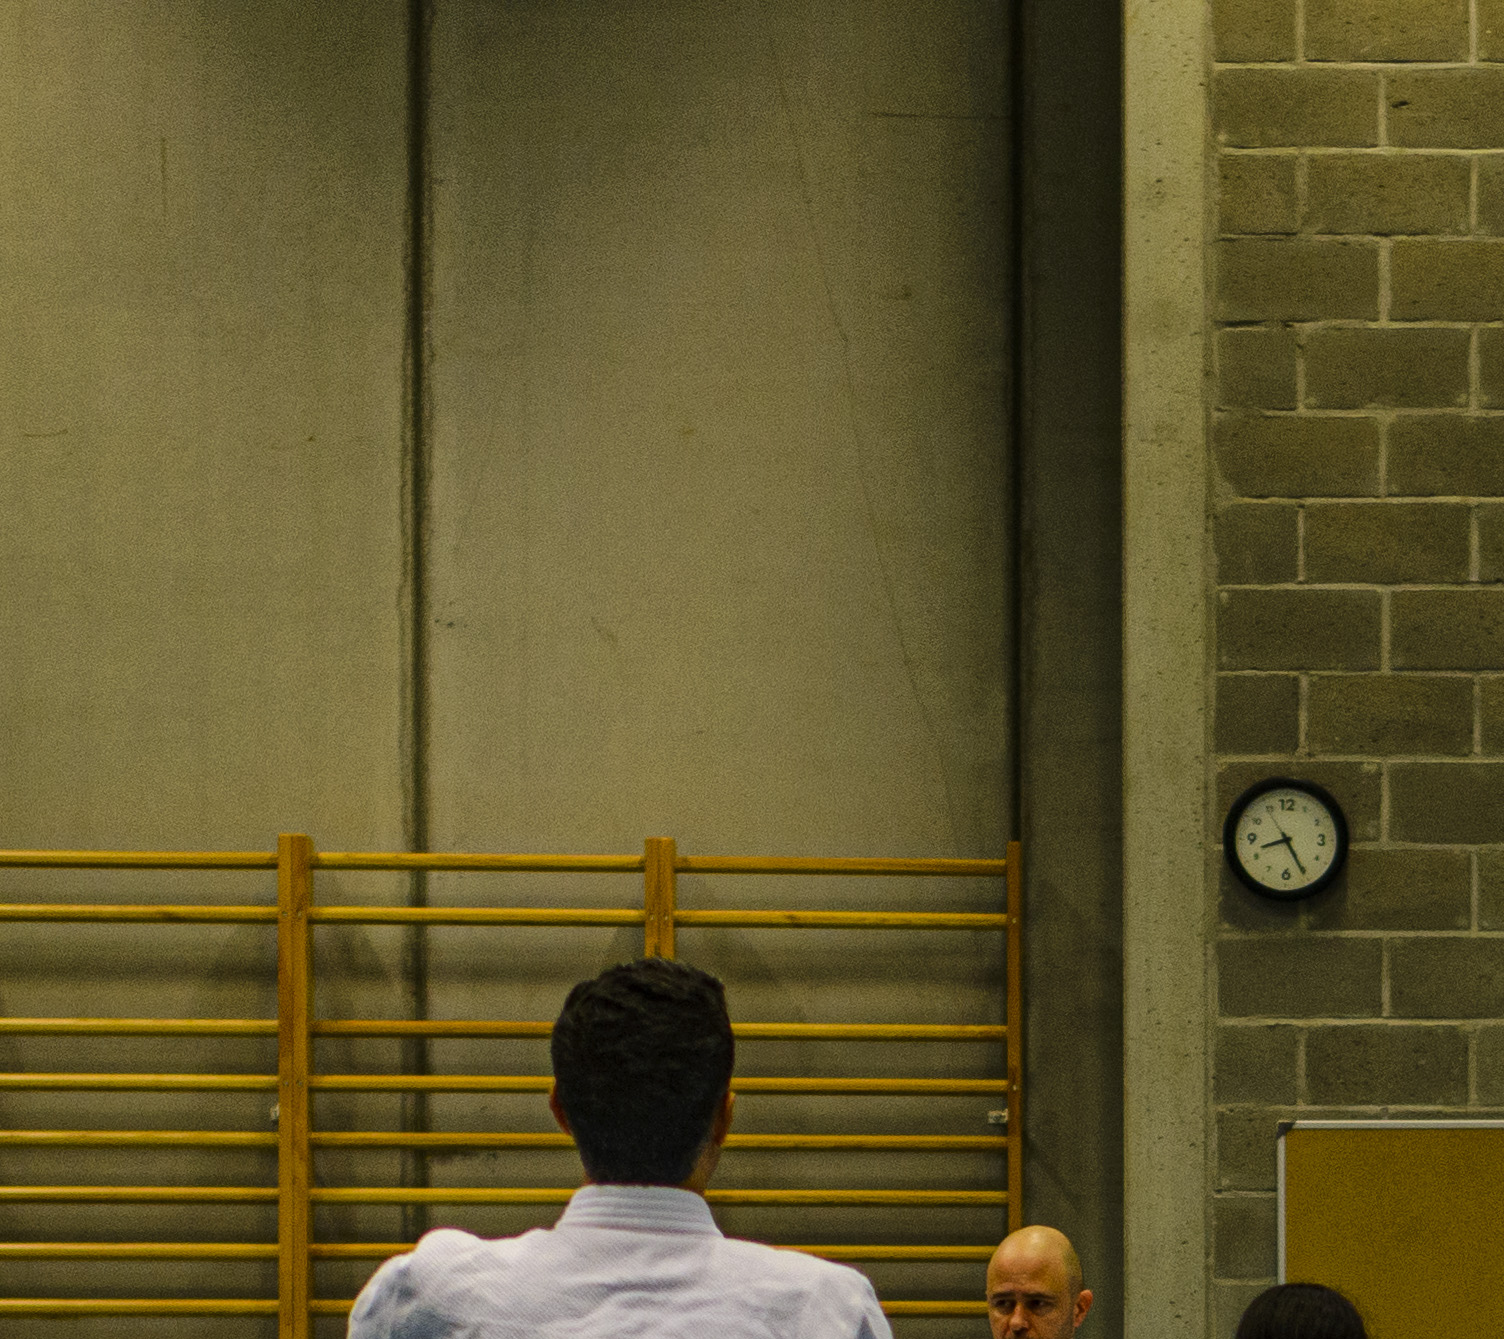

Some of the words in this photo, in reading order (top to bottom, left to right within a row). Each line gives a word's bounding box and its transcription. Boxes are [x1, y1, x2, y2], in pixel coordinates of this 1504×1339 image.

[1278, 798, 1296, 811] 12
[1314, 818, 1320, 827] 2
[1247, 832, 1257, 845] 9
[1317, 833, 1326, 847] 3
[1266, 865, 1272, 873] 7
[1281, 867, 1291, 880] 6
